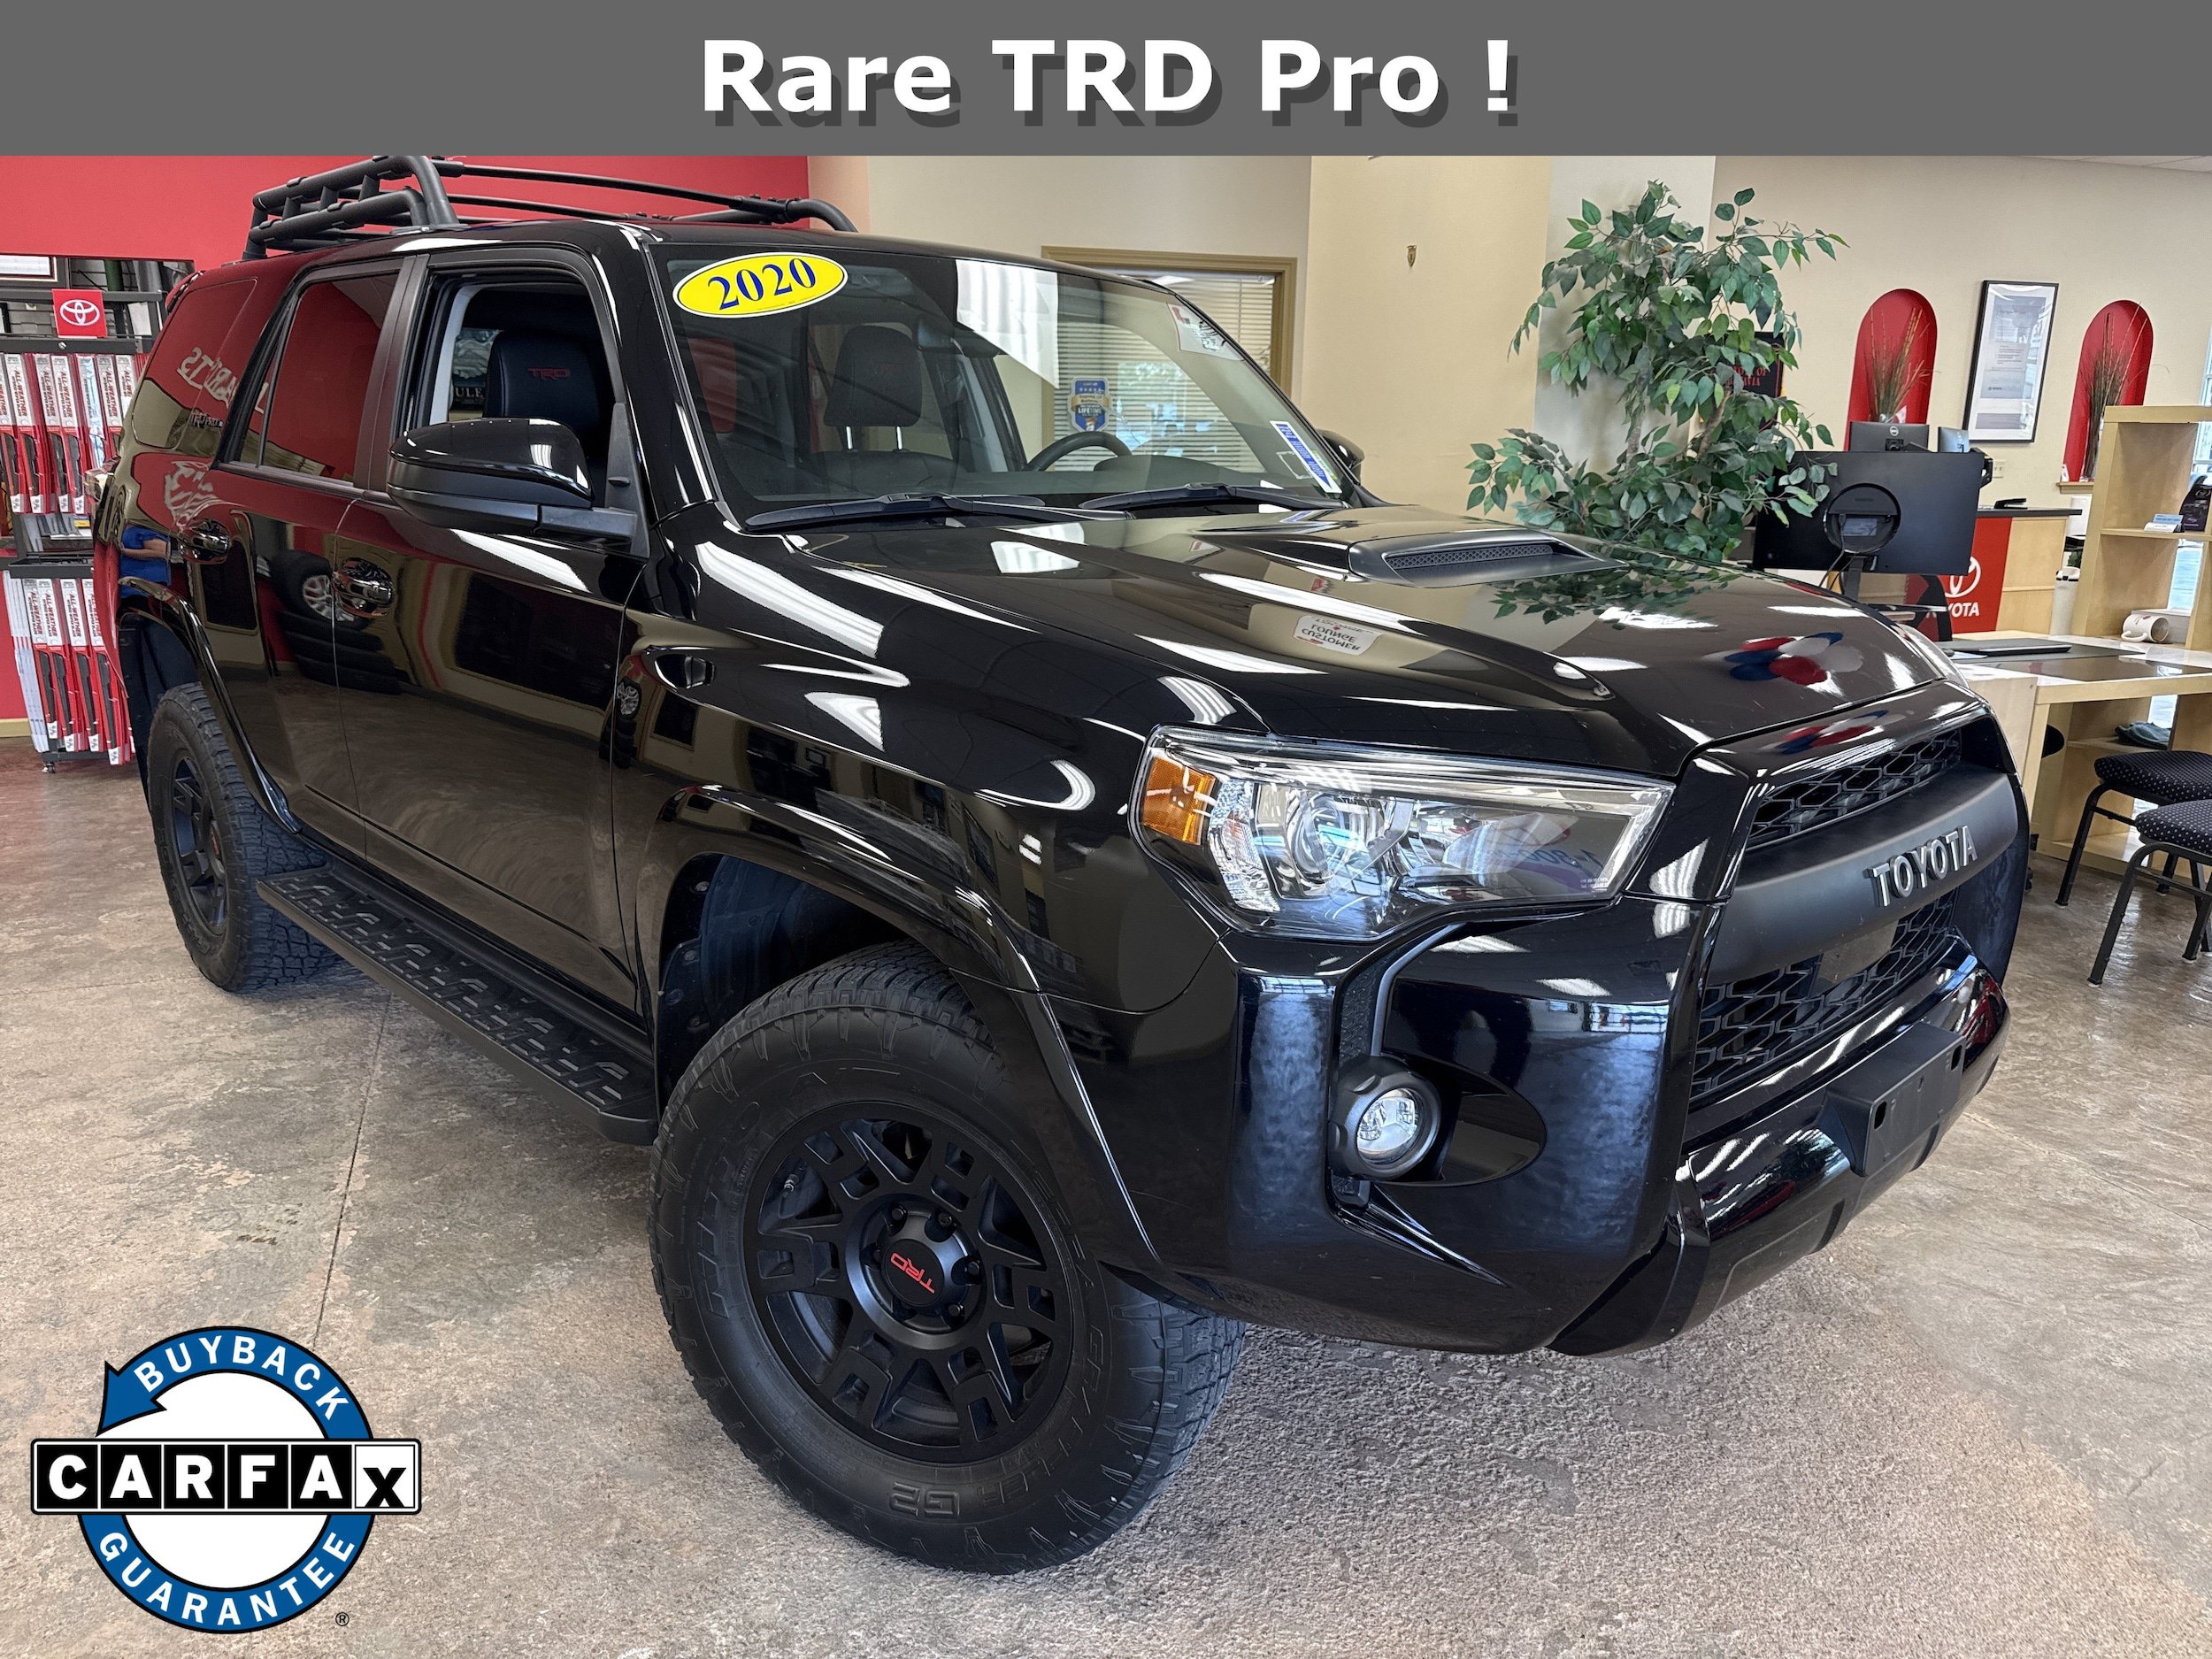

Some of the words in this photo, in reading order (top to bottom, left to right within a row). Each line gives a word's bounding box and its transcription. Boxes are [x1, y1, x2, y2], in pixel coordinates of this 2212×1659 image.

[707, 257, 816, 311] 2020
[14, 369, 27, 417] ALL-WEATHER
[43, 370, 56, 417] ALL-WEATHER
[60, 371, 73, 418] ALL-WEATHER
[105, 370, 118, 417] ALL-WEATHER
[527, 367, 572, 380] TRD
[31, 591, 42, 635] ALL-WEATHER
[45, 593, 58, 637] ALL-WEATHER
[69, 594, 81, 637] ALL-WEATHER
[1947, 601, 1980, 618] YOTA
[1863, 825, 1978, 907] TOYOTA
[890, 1252, 935, 1294] TRD
[889, 1480, 962, 1517] G2
